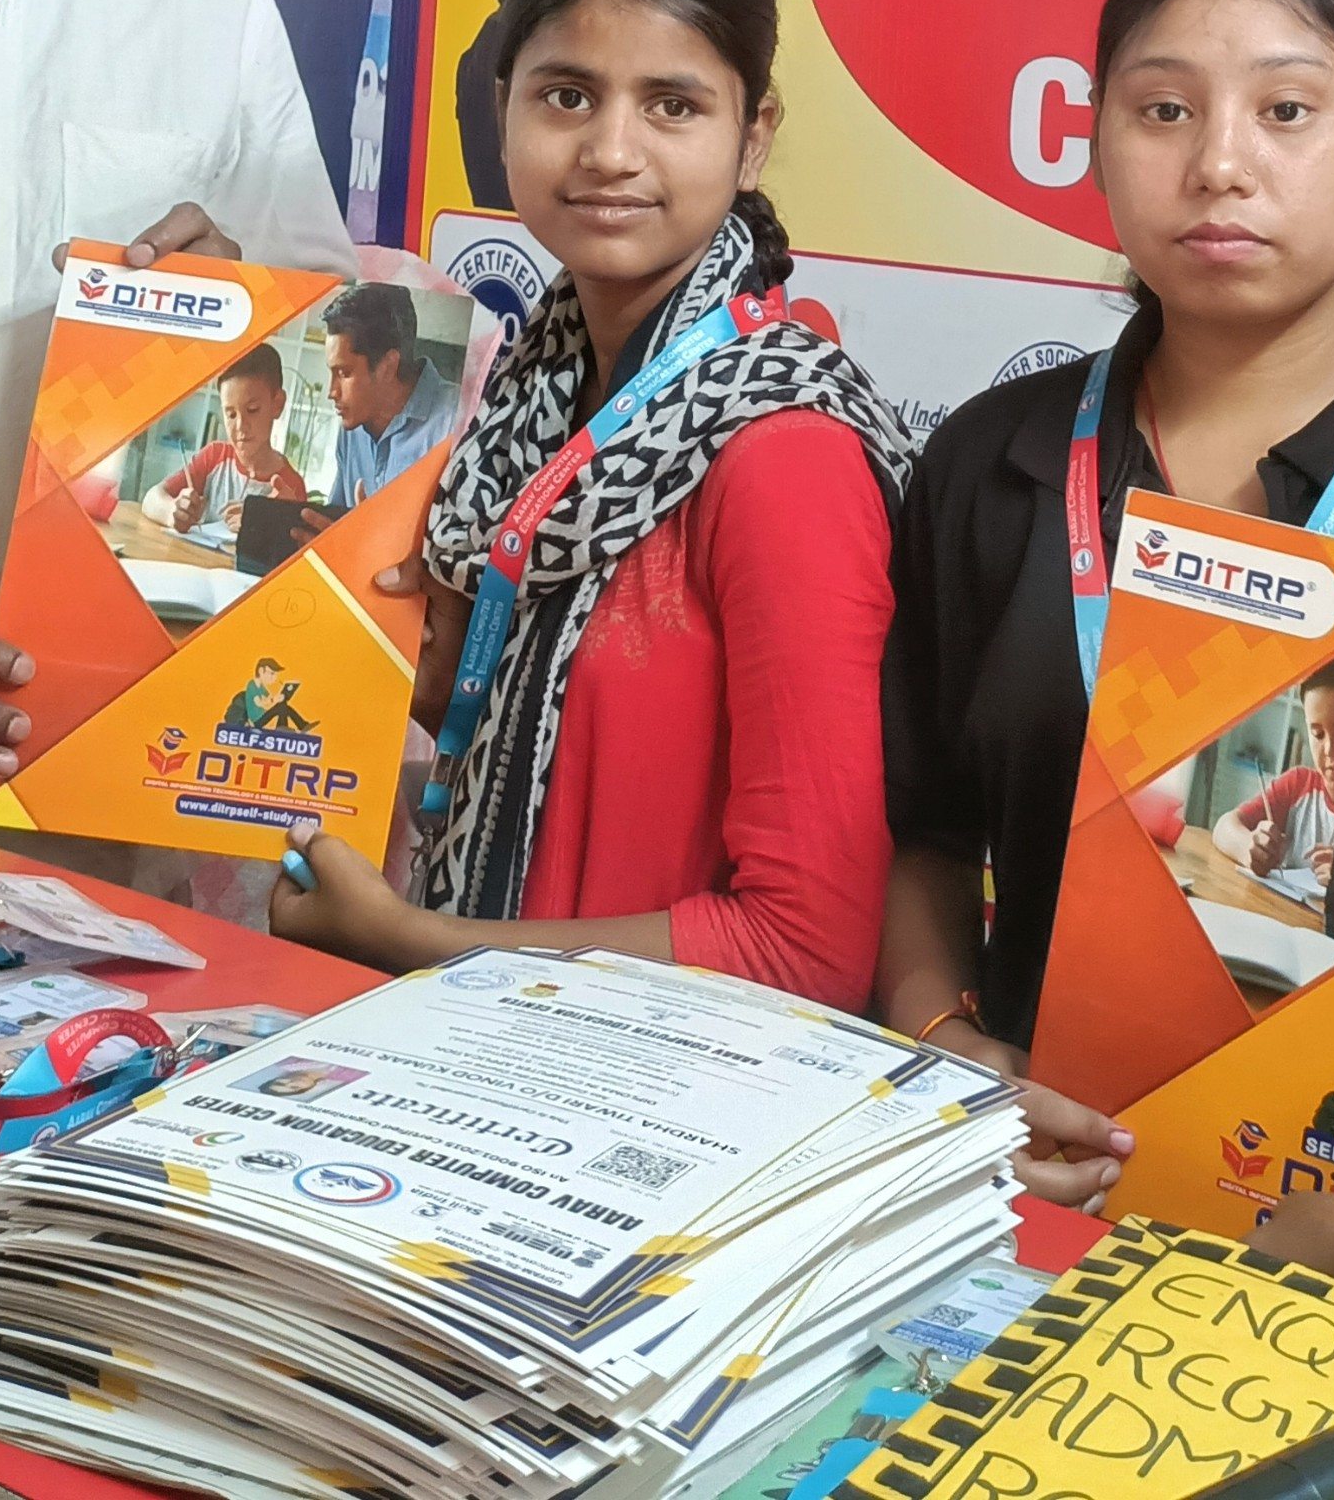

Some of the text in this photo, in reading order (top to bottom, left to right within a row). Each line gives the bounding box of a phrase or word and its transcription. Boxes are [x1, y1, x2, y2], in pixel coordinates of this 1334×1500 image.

[453, 248, 546, 300] CERTIFIED
[217, 729, 319, 756] SELF-STUDY
[497, 996, 763, 1067] AARAV COMPUTER EDUCATION CENTER
[183, 1094, 276, 1122] CENTER
[305, 1038, 742, 1156] SHARDHA TIWARI D/O VINOD KUMAR TIWARI
[272, 1114, 411, 1159] EDUCATION
[352, 1089, 574, 1158] Certificate
[408, 1148, 551, 1200] COMPUTER
[549, 1194, 643, 1232] AARAV
